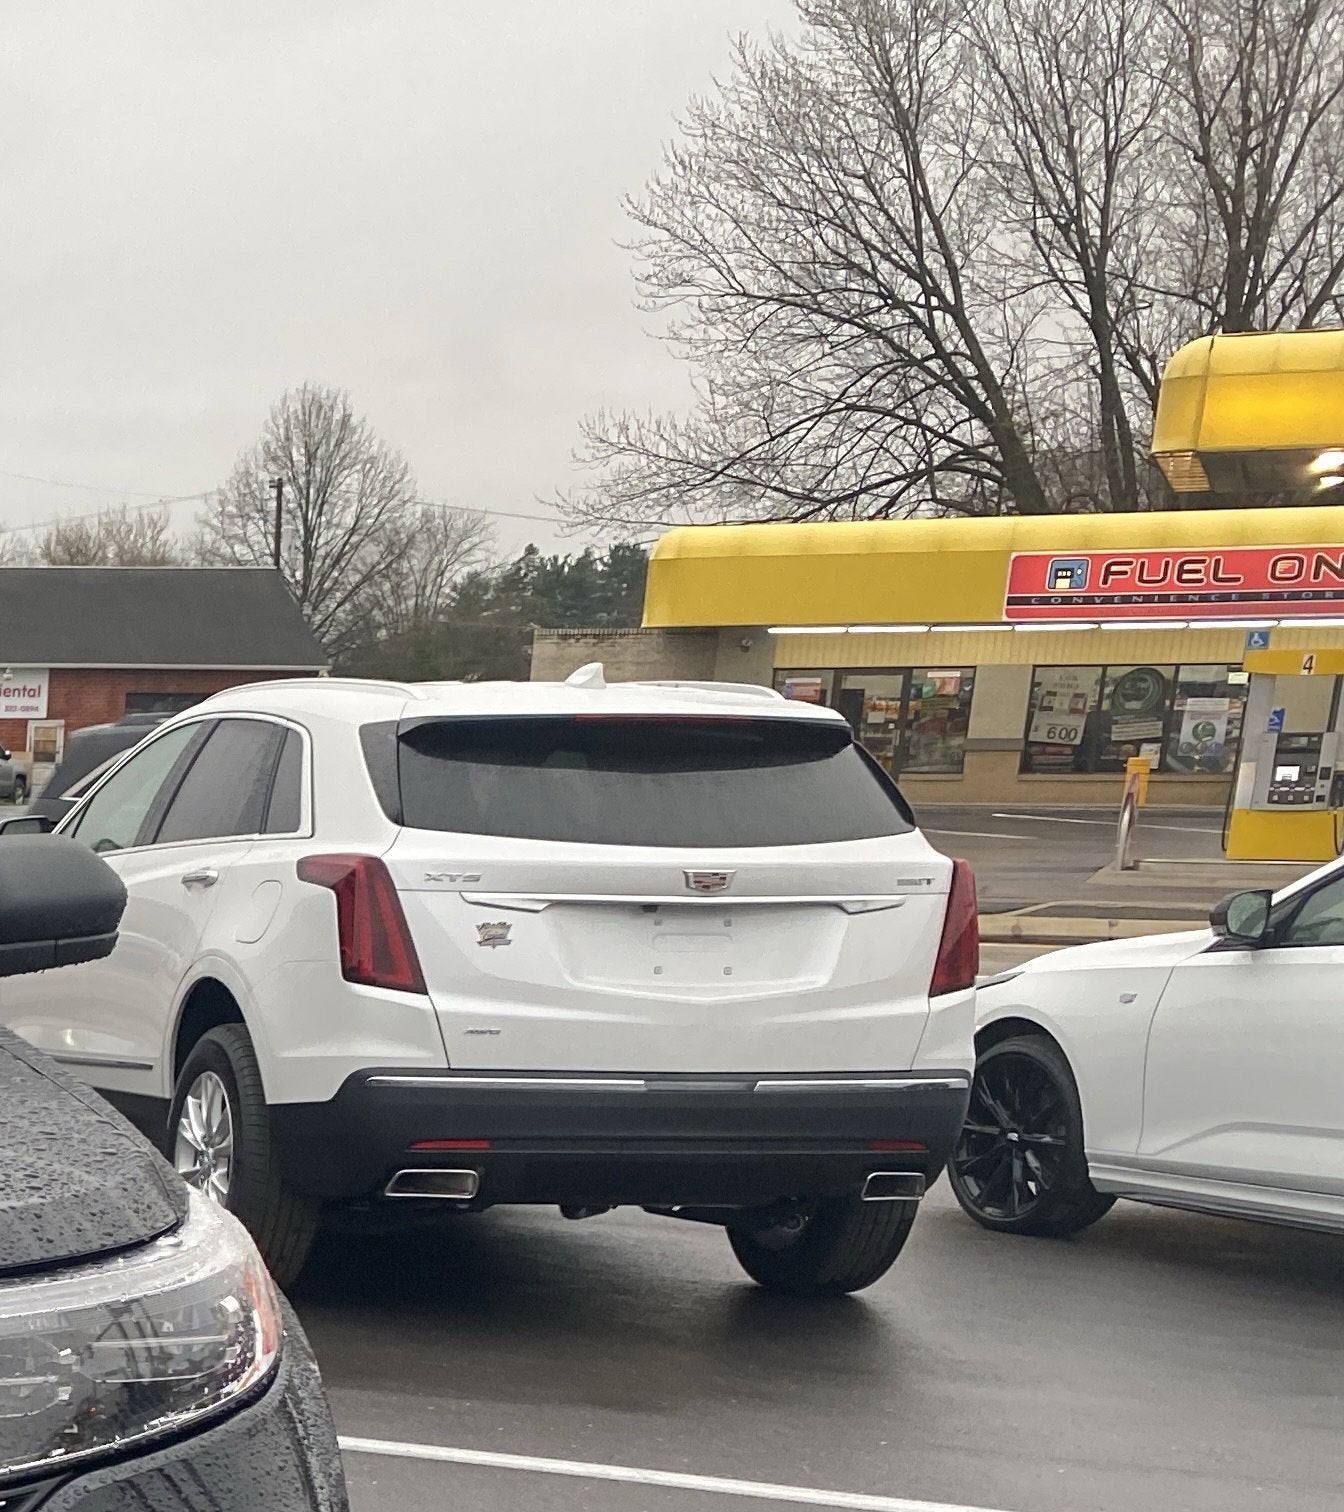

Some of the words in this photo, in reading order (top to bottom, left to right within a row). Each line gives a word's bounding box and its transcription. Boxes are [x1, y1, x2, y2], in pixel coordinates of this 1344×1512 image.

[1099, 556, 1243, 588] FUEL
[1031, 593, 1239, 605] CONVENIENCE
[1303, 654, 1314, 674] 4
[1047, 726, 1078, 741] 600
